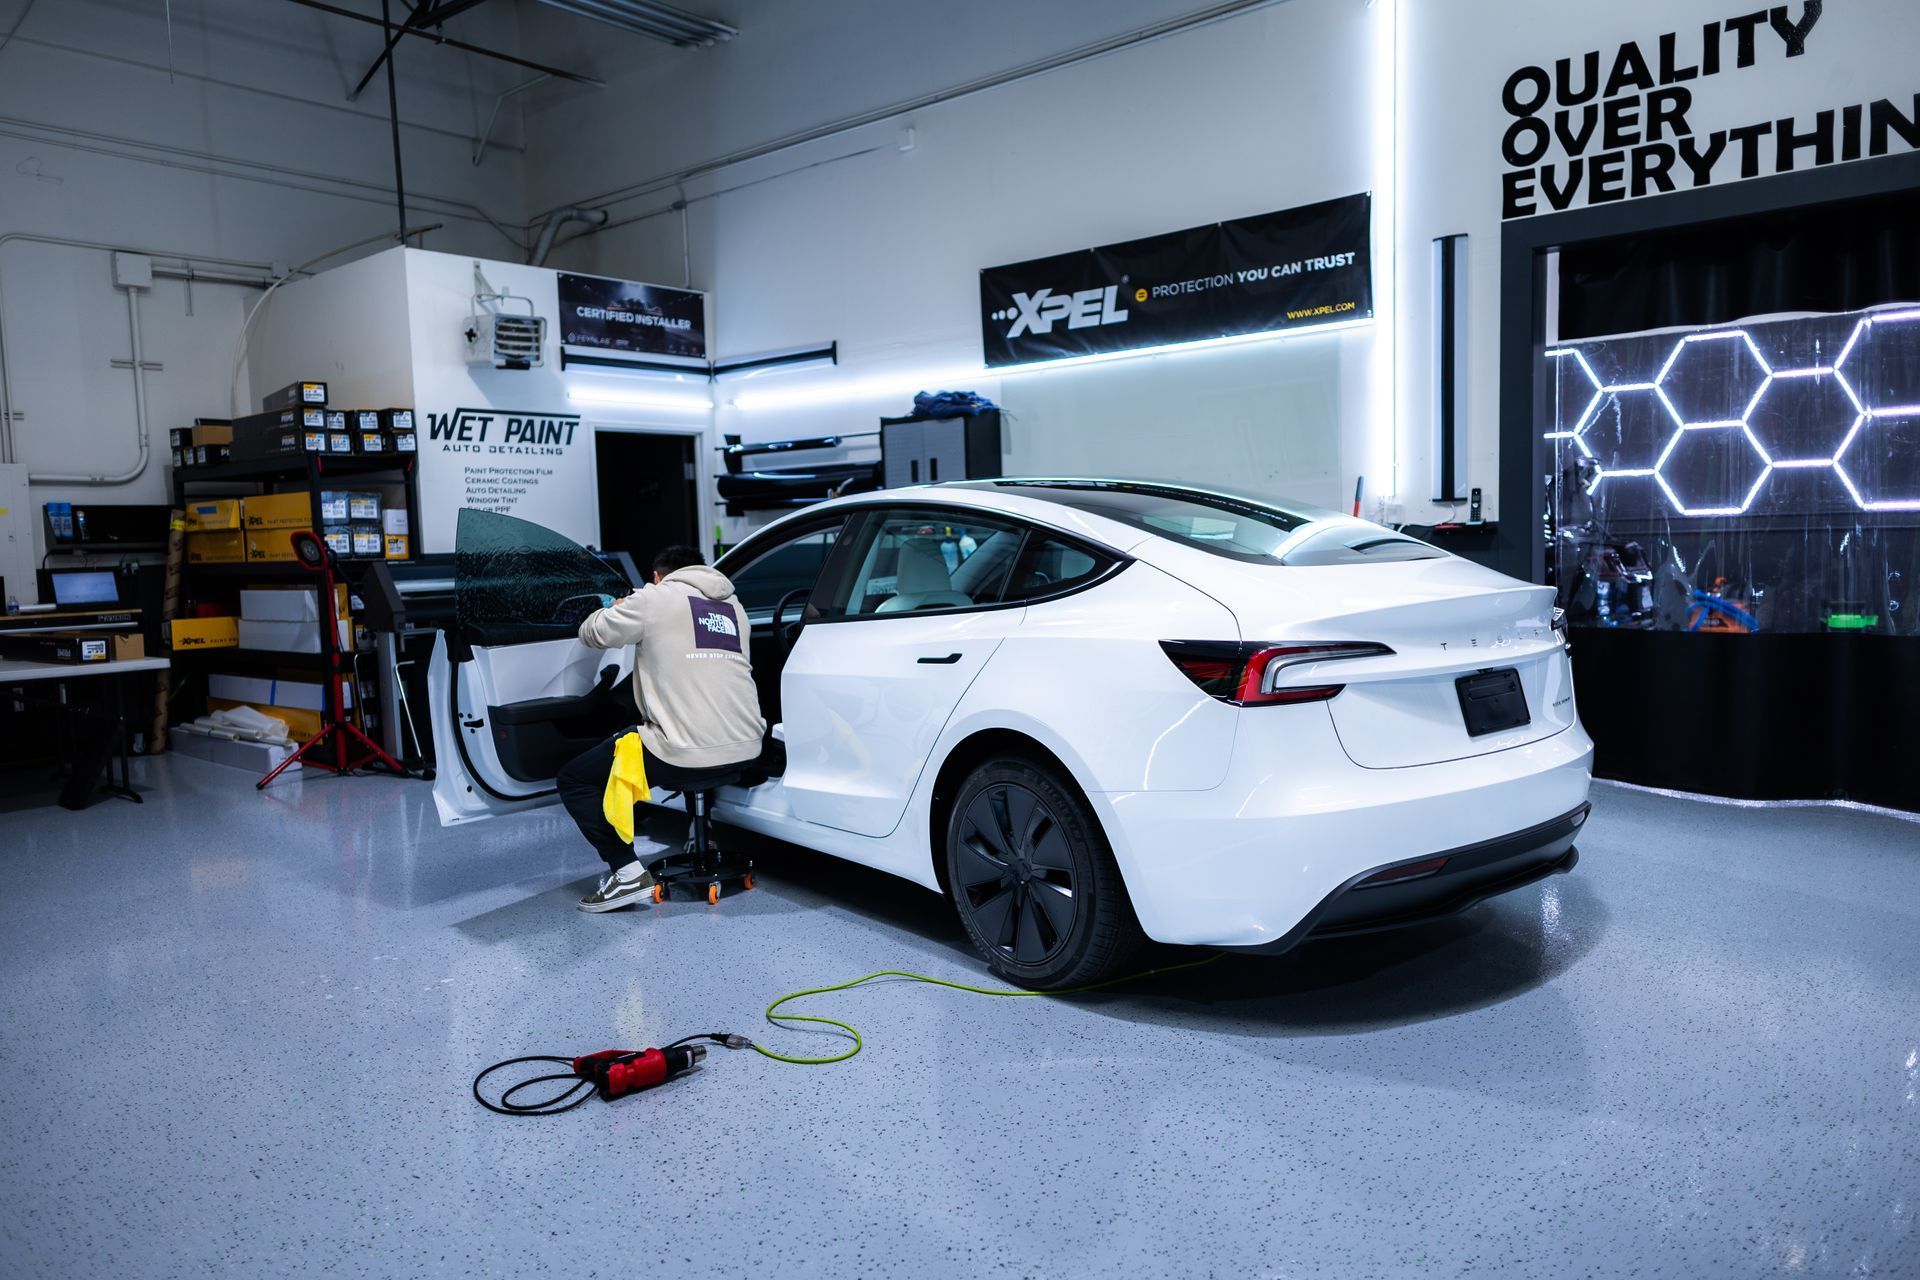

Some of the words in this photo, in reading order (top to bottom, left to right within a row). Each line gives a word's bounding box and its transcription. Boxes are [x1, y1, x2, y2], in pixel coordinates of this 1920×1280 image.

[1502, 0, 1823, 117] QUALITY
[1502, 86, 1692, 167] OVER
[1152, 273, 1234, 298] PROTECTION
[1237, 267, 1268, 283] YOU
[1271, 261, 1302, 278] CAN
[1305, 252, 1355, 272] TRUST
[1006, 284, 1129, 339] XPEL
[1286, 302, 1355, 319] WWW.XPEL.COM
[576, 306, 633, 323] CERTIFIED
[635, 313, 692, 330] INSTALLER
[427, 408, 494, 442] WET
[504, 418, 579, 445] PAINT
[443, 444, 481, 453] AUTO
[488, 445, 563, 455] DETAILING
[464, 466, 487, 475] PAINT
[488, 467, 534, 475] PROTECTION
[465, 477, 500, 485] CERAMIC
[466, 486, 487, 494] AUTO
[488, 487, 527, 495] DETAILING
[466, 496, 500, 504] WINDOW
[501, 496, 518, 504] TINT
[495, 505, 511, 513] PPF
[248, 516, 263, 525] XPEL
[708, 612, 724, 620] THE
[698, 617, 724, 628] NORTH
[708, 624, 726, 634] FACE
[182, 637, 206, 646] XPEL
